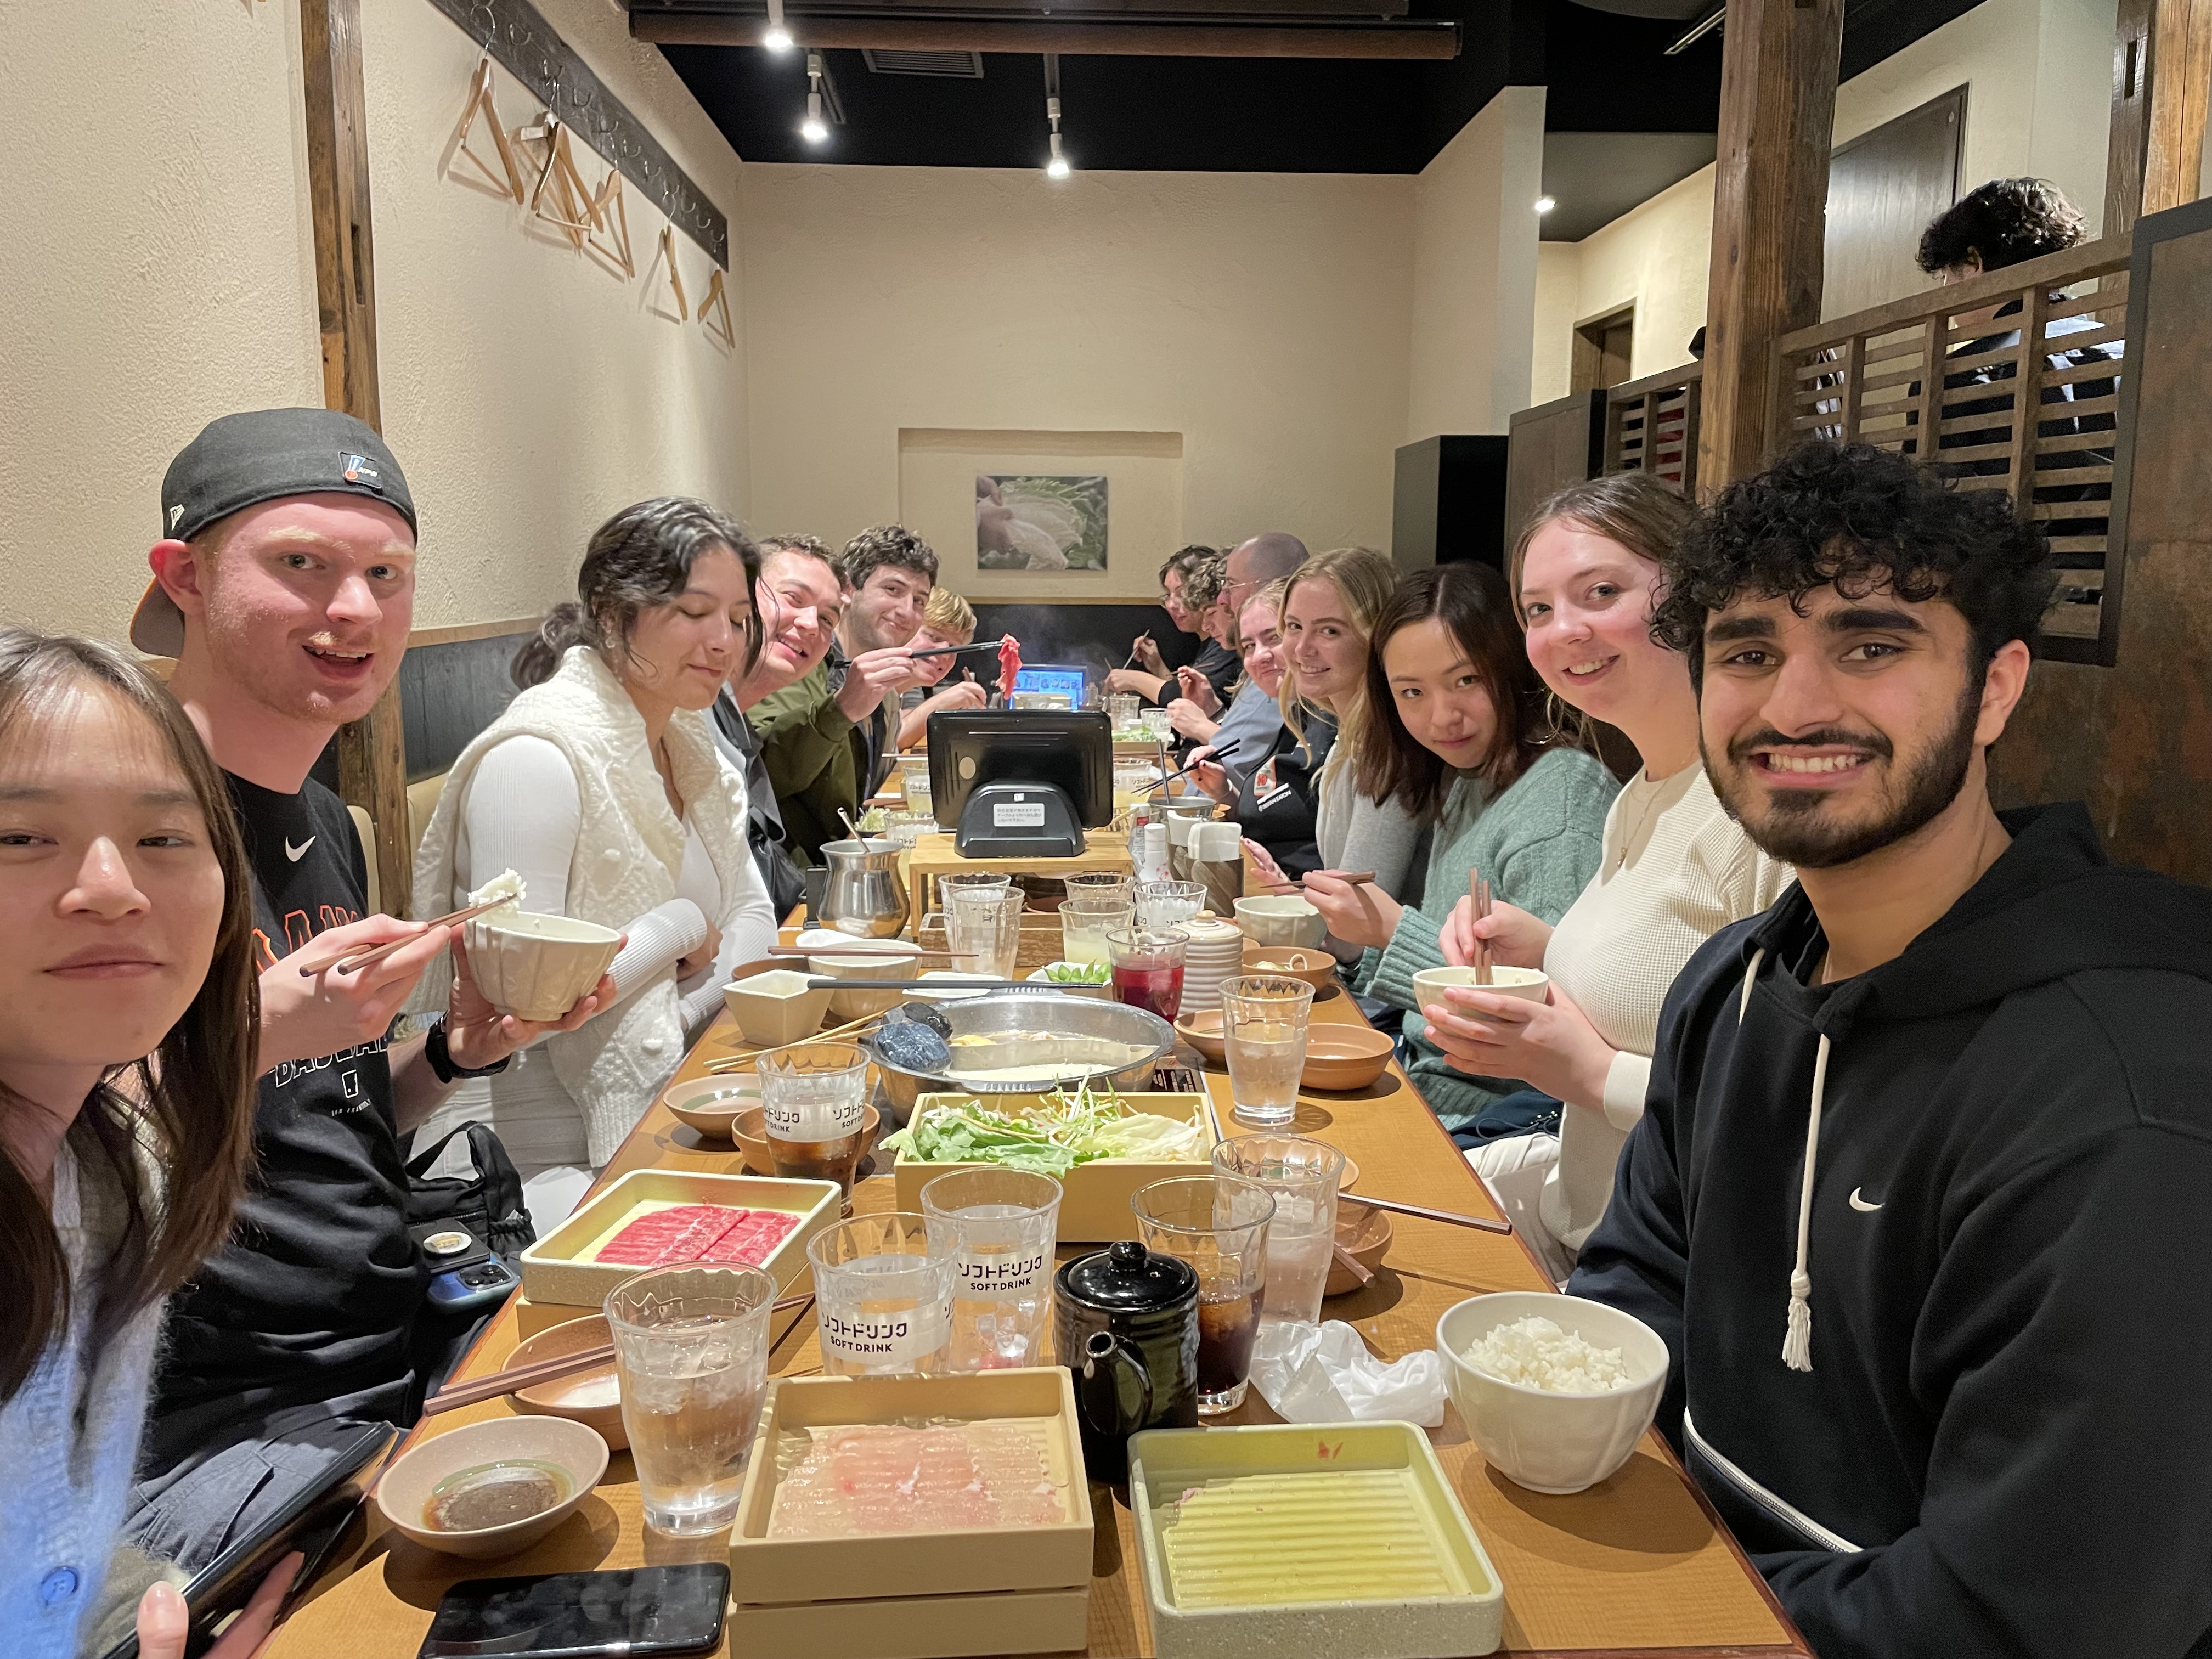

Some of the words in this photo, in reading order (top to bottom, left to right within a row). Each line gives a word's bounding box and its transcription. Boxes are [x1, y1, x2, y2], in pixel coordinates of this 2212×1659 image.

[358, 467, 377, 477] NPB
[770, 1122, 791, 1133] DRINK
[842, 1118, 857, 1128] SOFT
[958, 1255, 1042, 1278] ソフトドリンク
[970, 1283, 997, 1291] SOFT
[1000, 1277, 1031, 1290] DRINK
[822, 1312, 907, 1339] ソフトドリンク
[831, 1336, 854, 1350] SOFT
[856, 1343, 893, 1352] DRINK
